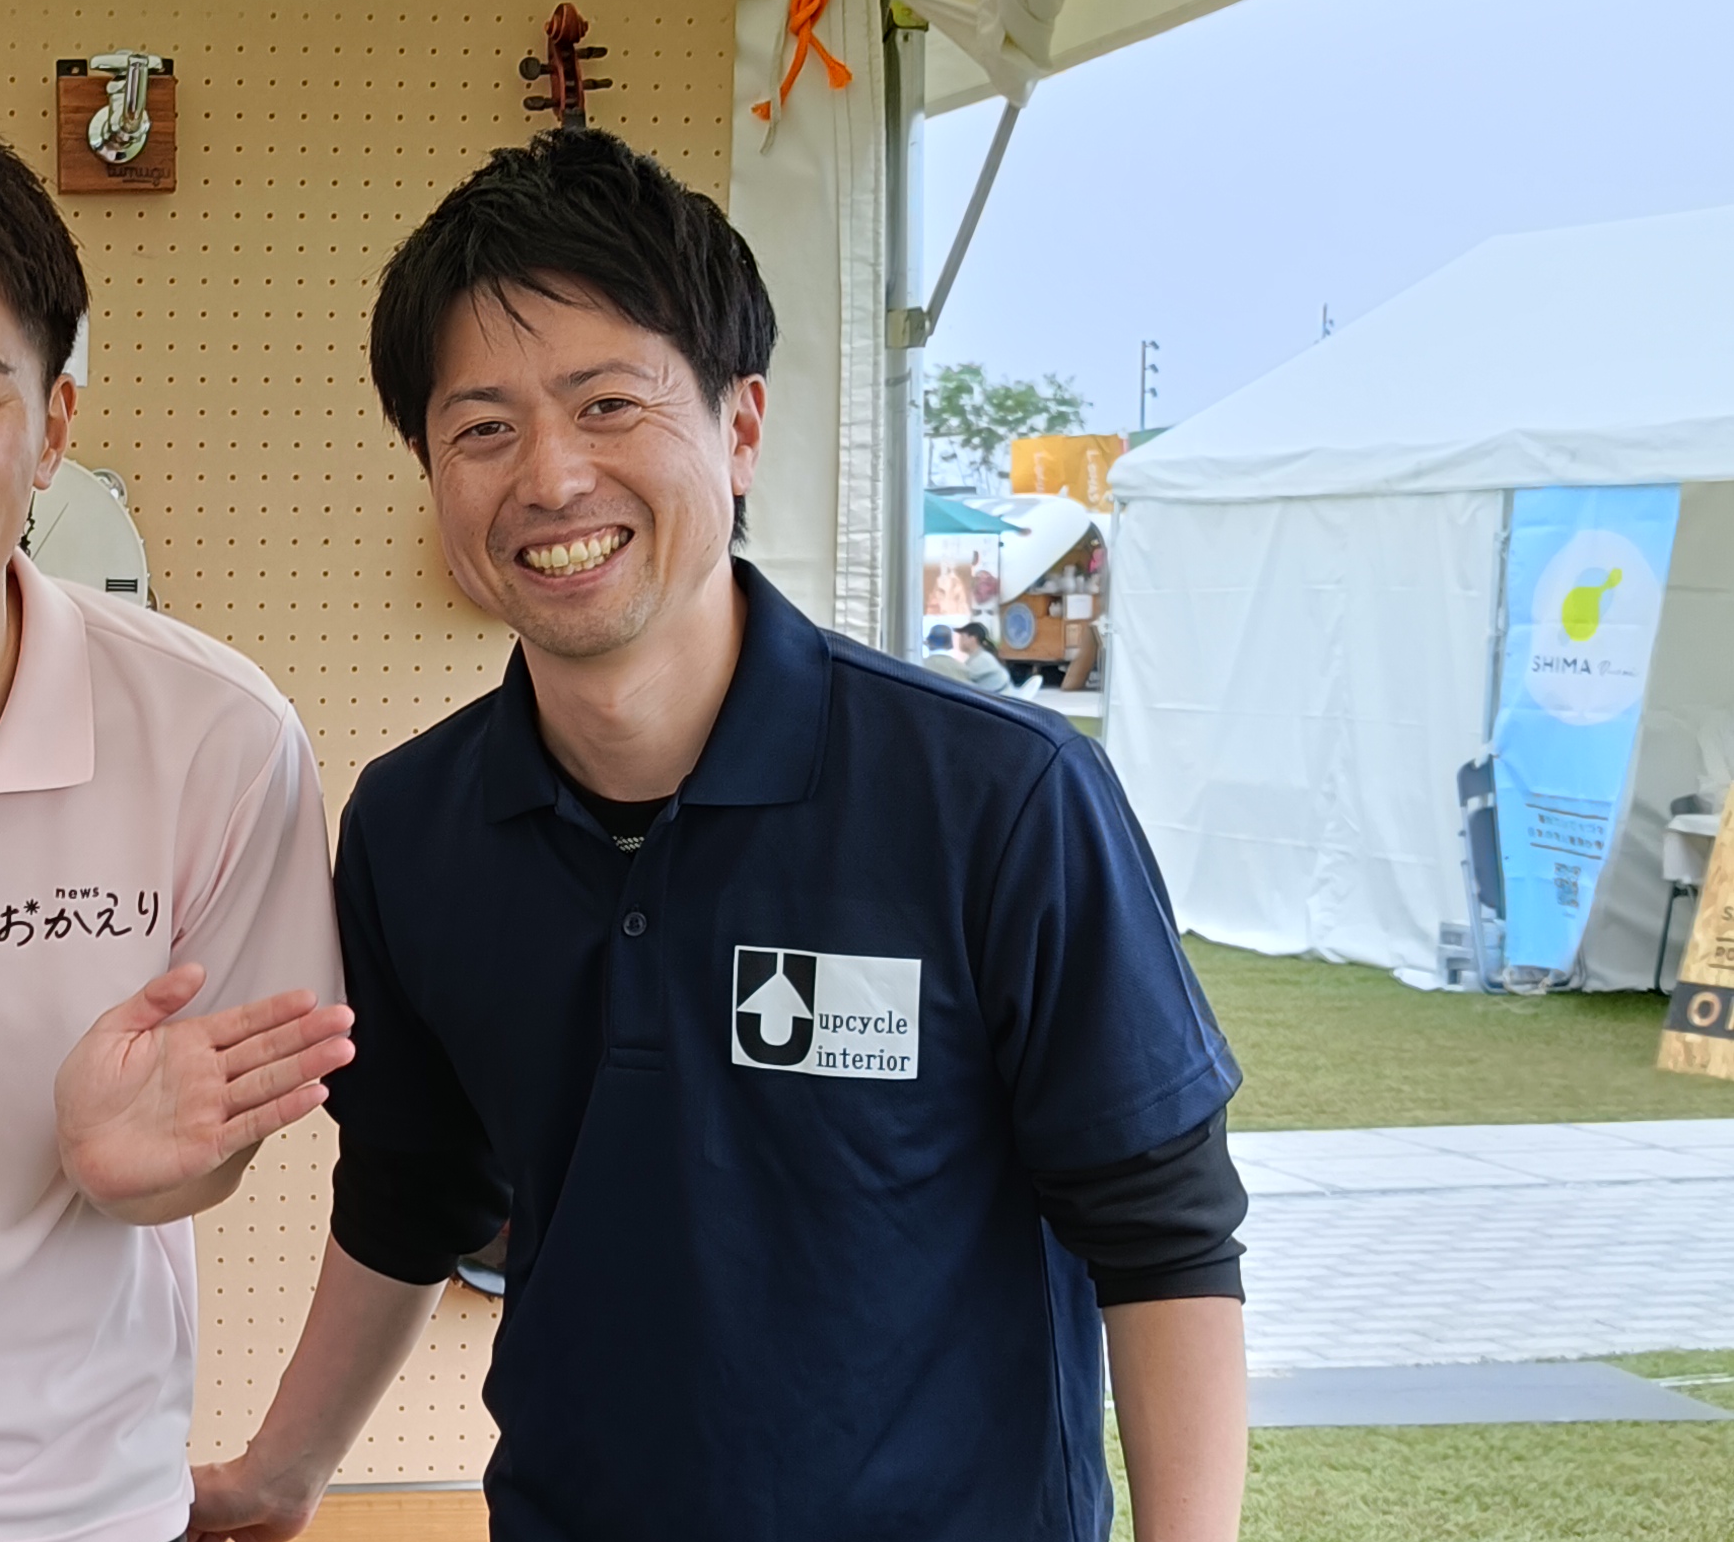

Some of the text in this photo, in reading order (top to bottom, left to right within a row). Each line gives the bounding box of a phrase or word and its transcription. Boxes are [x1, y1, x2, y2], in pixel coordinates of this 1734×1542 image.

[1531, 655, 1592, 675] SHIMA
[55, 886, 100, 899] news
[818, 1010, 908, 1035] upcycle
[816, 1045, 911, 1072] interior
